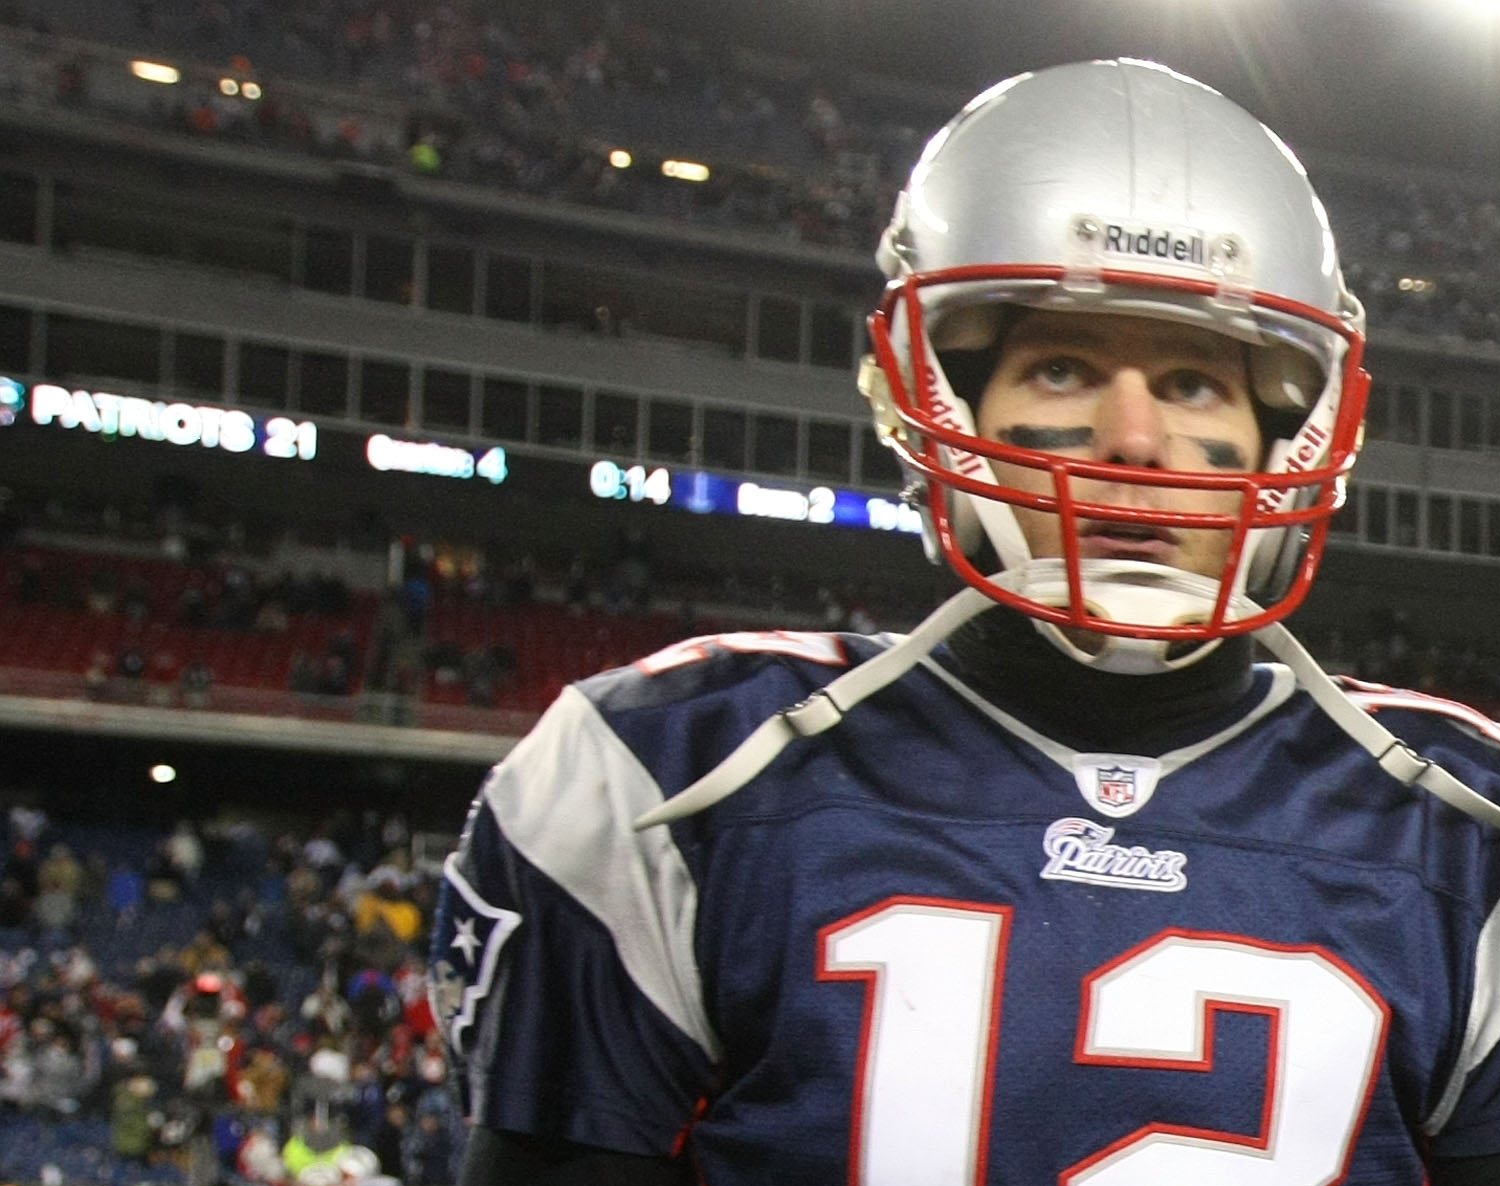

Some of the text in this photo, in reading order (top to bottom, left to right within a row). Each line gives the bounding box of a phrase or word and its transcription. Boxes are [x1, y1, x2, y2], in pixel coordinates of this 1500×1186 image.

[1105, 225, 1204, 265] Riddell
[31, 384, 255, 452] PATRIOTS
[264, 417, 317, 460] 21
[1044, 836, 1186, 882] Patriots
